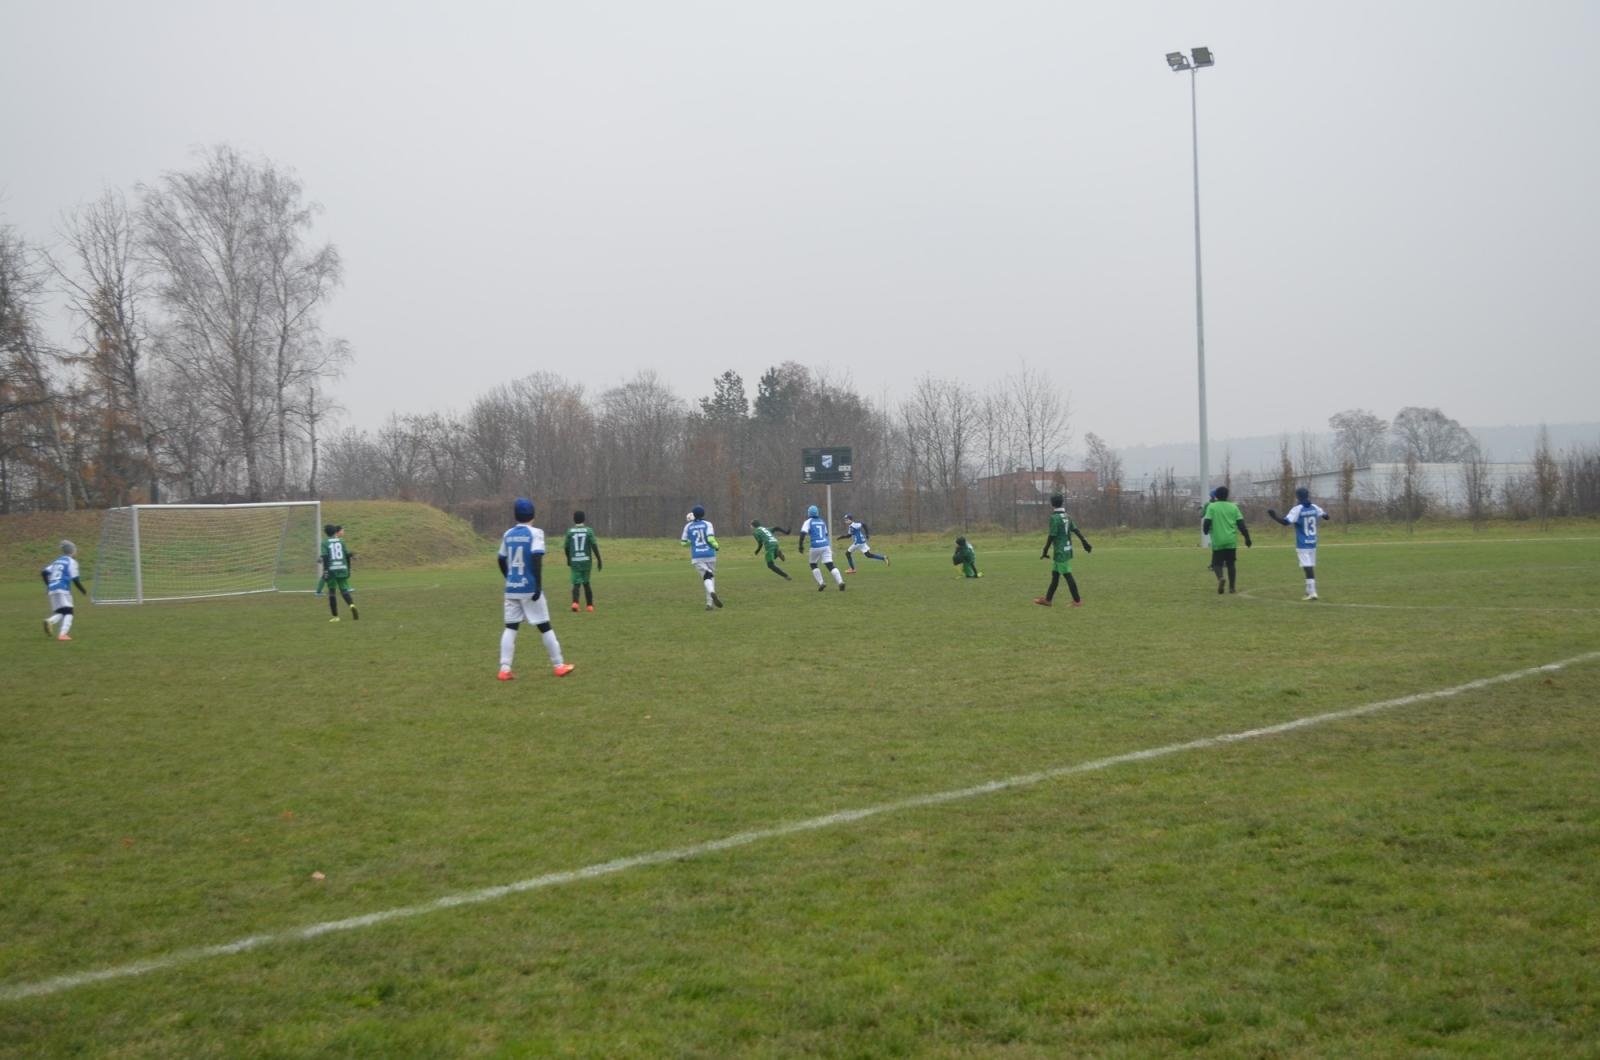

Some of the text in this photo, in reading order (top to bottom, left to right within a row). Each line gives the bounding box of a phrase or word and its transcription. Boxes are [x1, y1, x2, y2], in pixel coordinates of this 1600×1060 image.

[1304, 516, 1317, 536] 13
[572, 532, 587, 551] 17
[692, 528, 707, 546] 21
[328, 542, 343, 560] 18
[507, 545, 525, 576] 14
